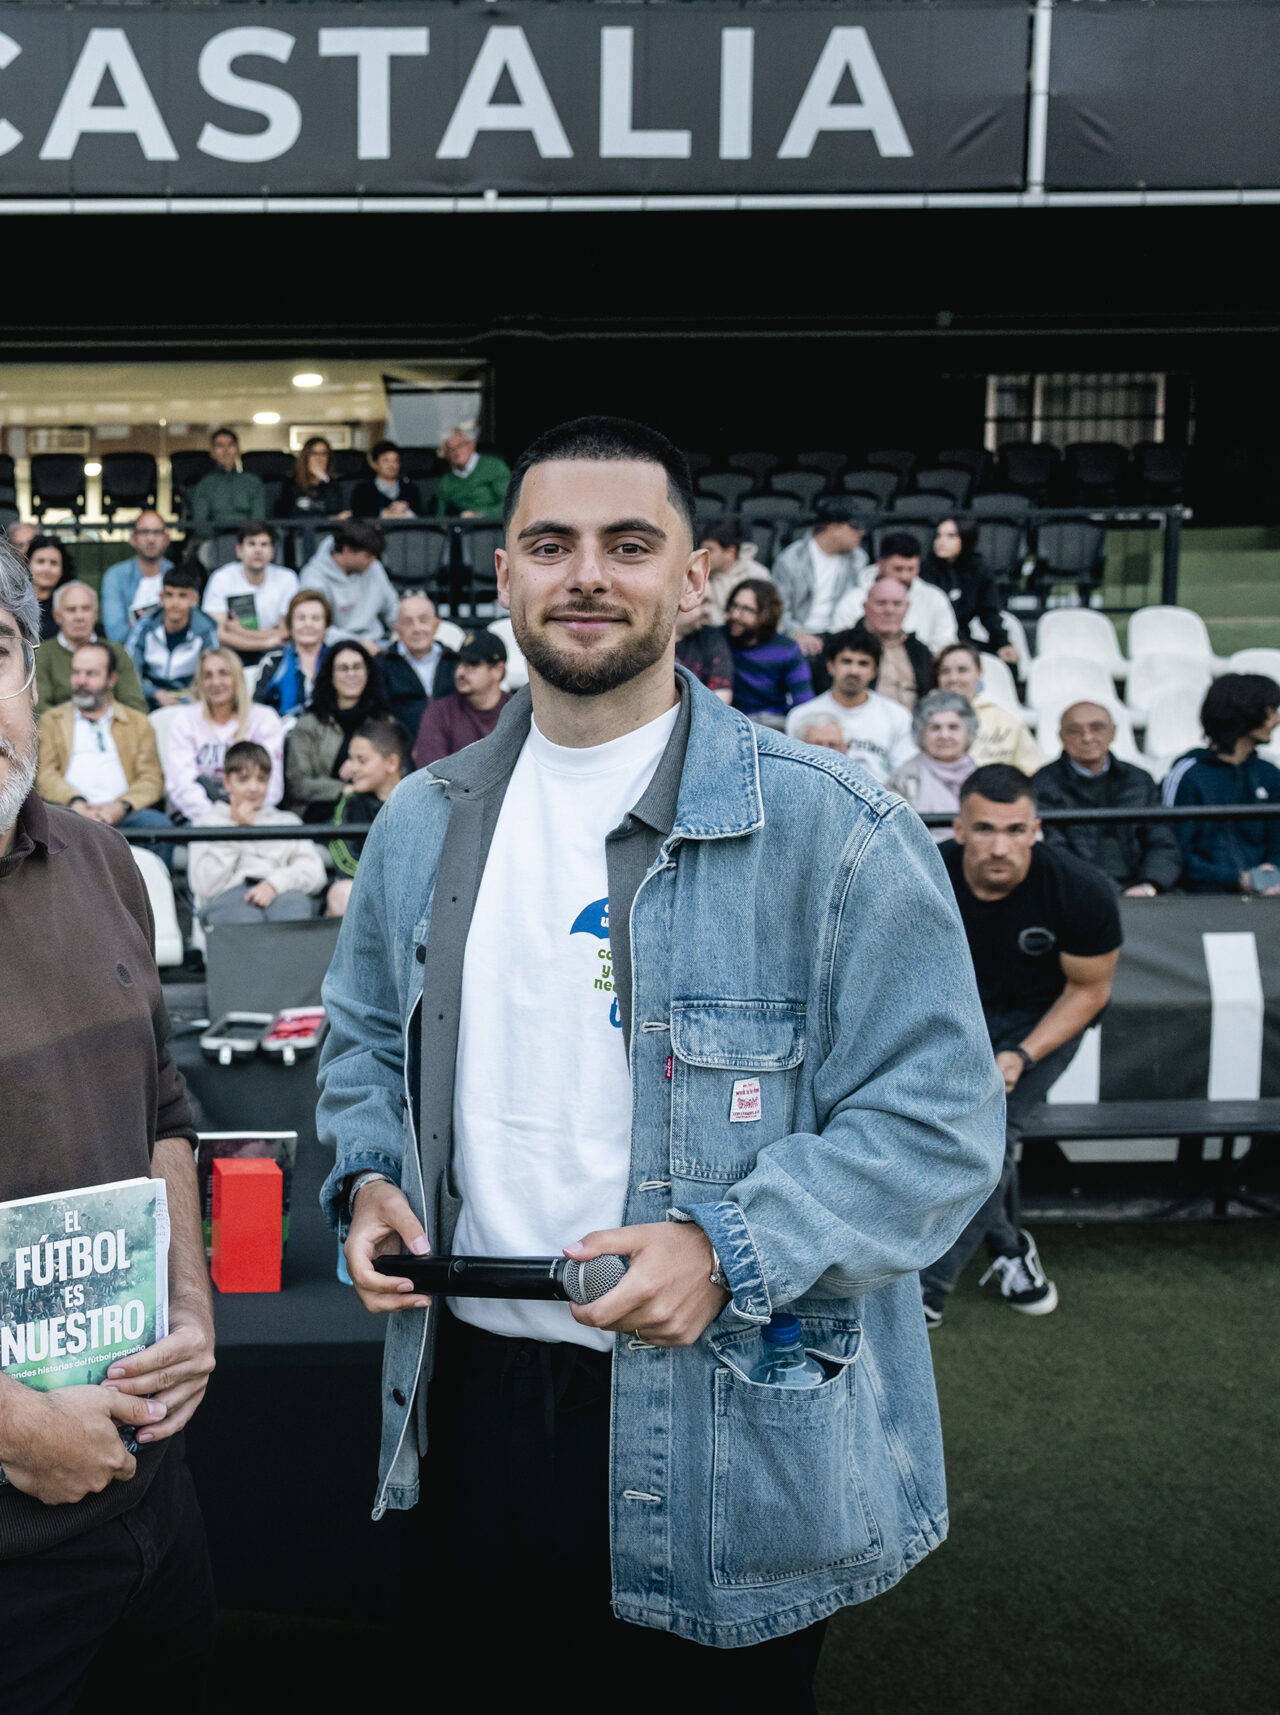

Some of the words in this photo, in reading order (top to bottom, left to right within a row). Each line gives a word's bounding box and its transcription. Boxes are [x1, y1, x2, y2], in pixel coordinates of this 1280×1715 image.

[64, 1210, 82, 1233] EL
[15, 1228, 131, 1290] FÚTBOL
[64, 1284, 85, 1308] ES
[1, 1299, 145, 1367] NUESTRO
[11, 1370, 37, 1380] andes
[37, 1362, 74, 1376] historias
[74, 1358, 87, 1369] del
[87, 1351, 112, 1366] fútbol
[111, 1344, 146, 1361] pequeño
